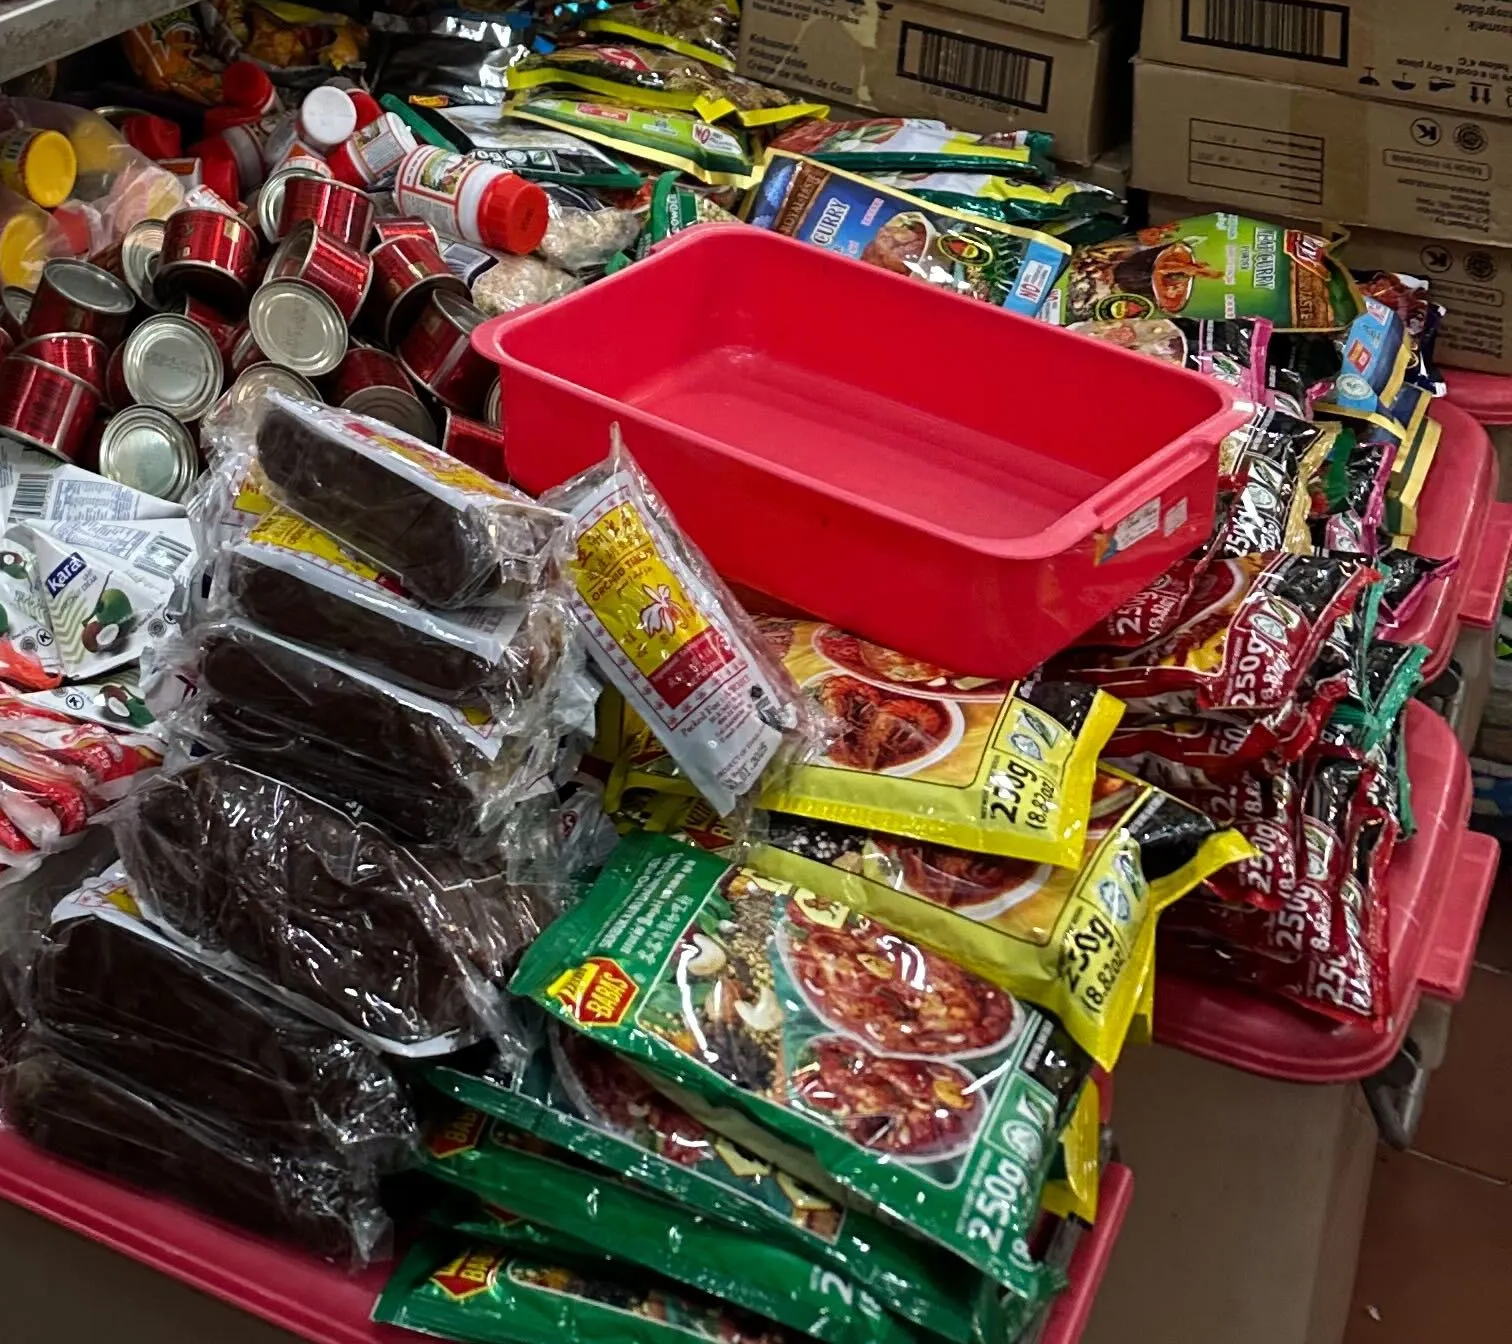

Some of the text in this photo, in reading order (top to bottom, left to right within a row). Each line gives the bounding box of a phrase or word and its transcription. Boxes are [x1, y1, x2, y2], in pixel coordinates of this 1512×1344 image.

[693, 123, 710, 143] NO
[812, 195, 851, 245] CURRY
[1254, 250, 1276, 291] CURRY
[46, 556, 85, 592] kara
[590, 567, 626, 603] ORCHID
[1230, 629, 1276, 707] 250g
[585, 971, 630, 1018] BABAS
[965, 1152, 1031, 1254] 250g
